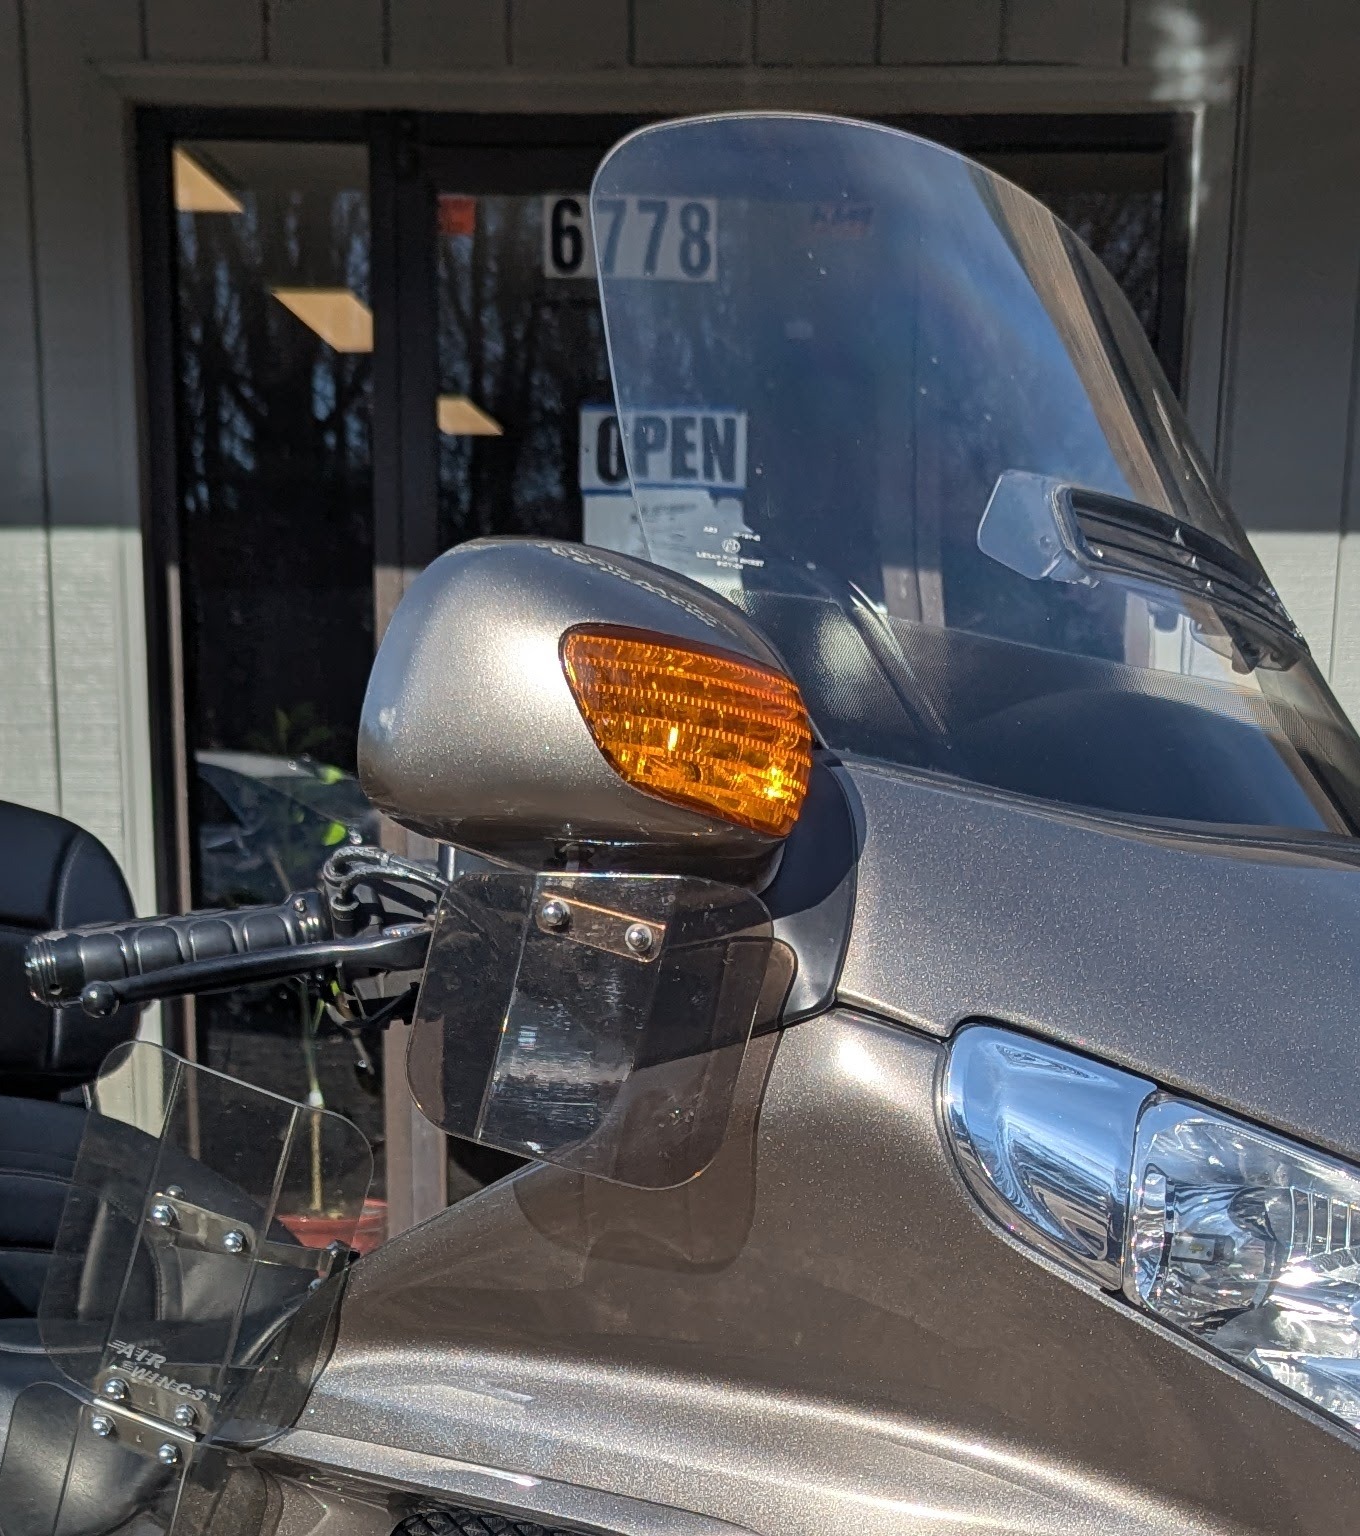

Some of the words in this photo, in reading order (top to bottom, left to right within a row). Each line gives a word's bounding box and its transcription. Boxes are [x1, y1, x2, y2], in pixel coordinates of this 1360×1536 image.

[551, 199, 711, 277] 6778
[597, 415, 737, 486] OPEN
[116, 1343, 167, 1370] AIR
[130, 1365, 207, 1401] WINGS
